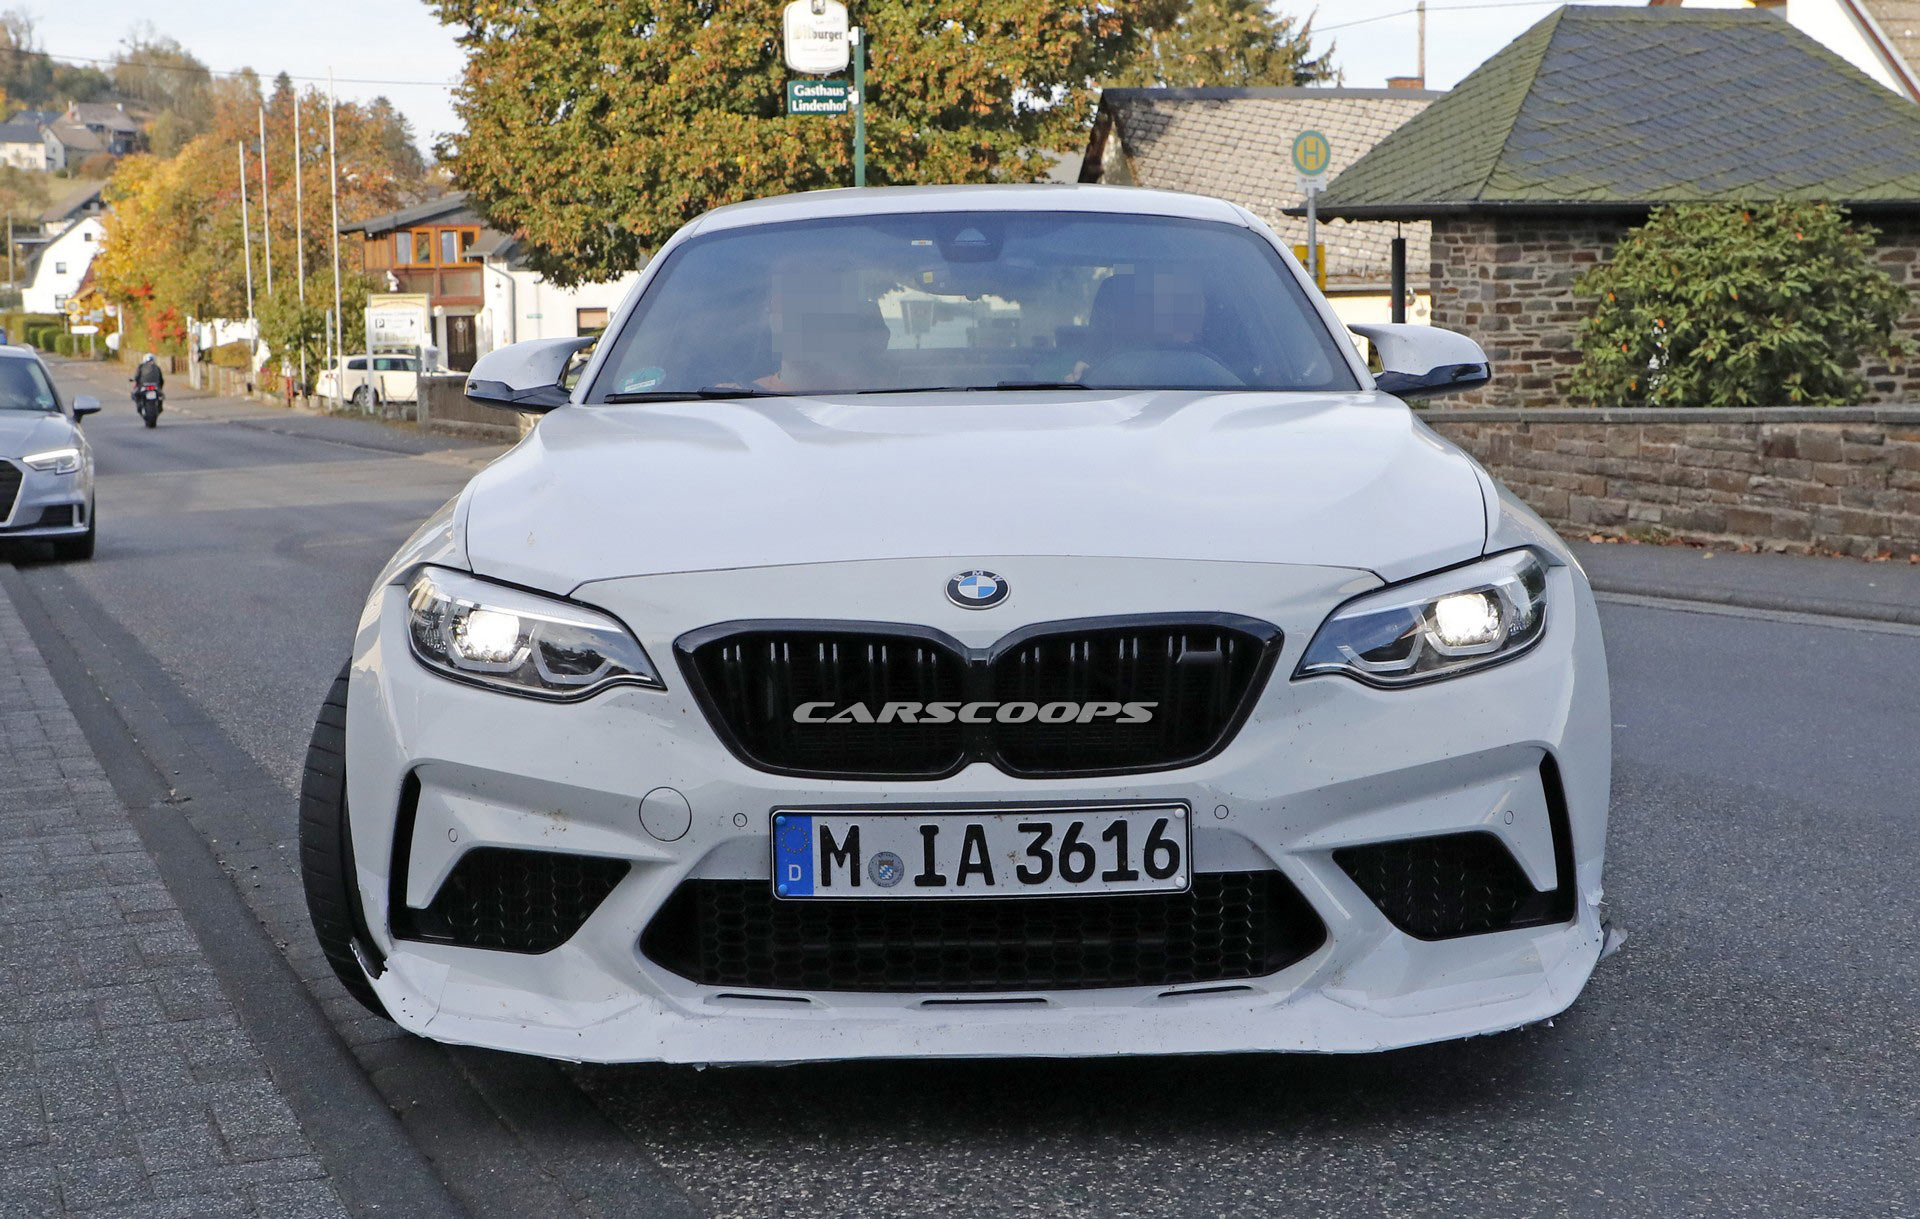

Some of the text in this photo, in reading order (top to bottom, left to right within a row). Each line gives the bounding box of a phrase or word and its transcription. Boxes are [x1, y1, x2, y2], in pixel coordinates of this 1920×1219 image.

[794, 84, 844, 97] Gasthaus
[792, 99, 847, 112] Lindenhof
[1303, 140, 1319, 167] H
[953, 570, 1003, 582] BMW
[819, 824, 861, 887] M
[914, 823, 996, 887] IA
[1016, 817, 1181, 885] 3616
[788, 864, 802, 881] D
